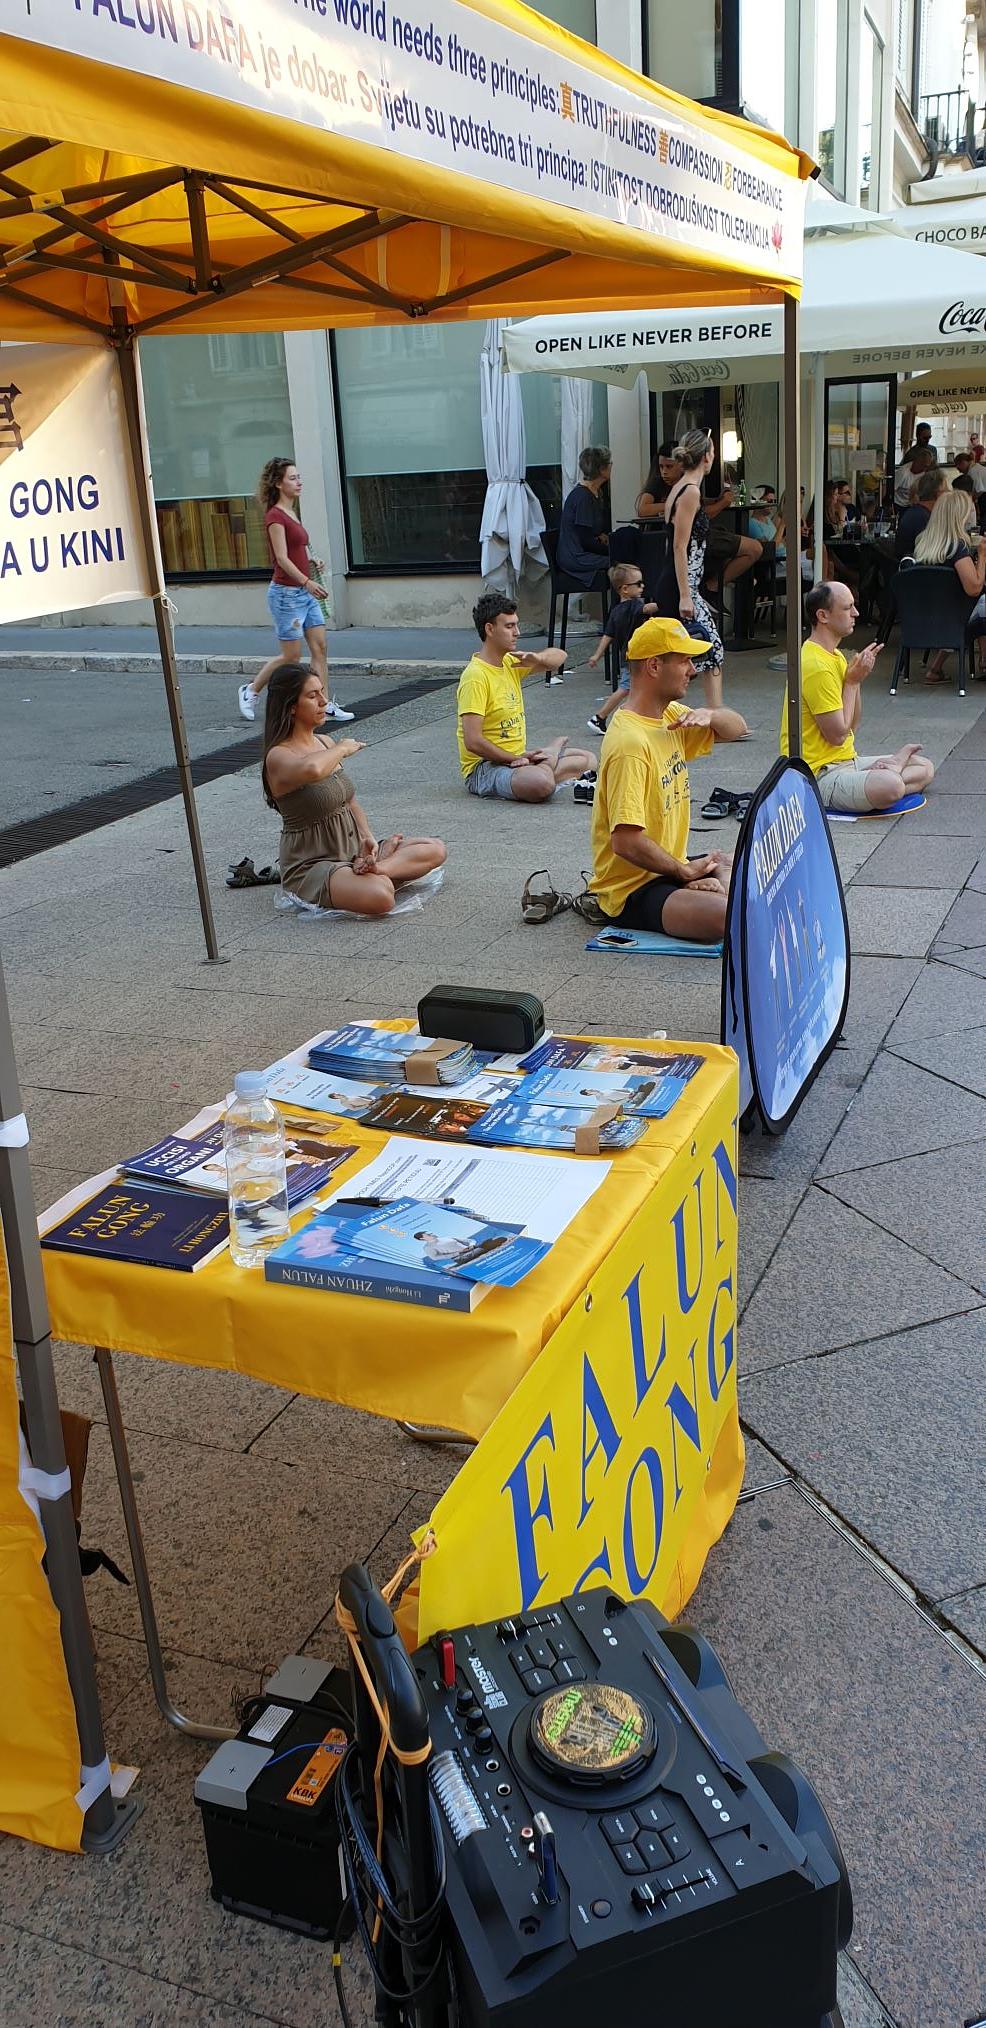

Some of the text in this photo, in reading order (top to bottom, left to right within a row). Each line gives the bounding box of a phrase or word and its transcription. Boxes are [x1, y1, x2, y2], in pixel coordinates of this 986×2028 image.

[332, 0, 387, 42] world
[392, 15, 443, 66] needs
[448, 33, 487, 85] three
[491, 58, 560, 115] principles:
[183, 1, 258, 73] DAFA
[258, 31, 282, 89] je
[287, 45, 355, 107] dobar.
[357, 70, 421, 131] Svijetu
[425, 105, 447, 140] su
[449, 114, 516, 163] potrebna
[518, 133, 534, 169] tri
[536, 142, 588, 192] principa:
[645, 183, 719, 234] DOBRODUŠNOST
[720, 211, 770, 250] TOLERANCIJA
[573, 90, 657, 157] TRUTHFULNESS
[668, 136, 724, 186] COMPASSION
[732, 167, 783, 212] FORBEARANCE
[915, 228, 967, 243] CHOCO
[535, 322, 773, 354] OPEN LIKE NEVER BEFORE
[910, 389, 935, 398] OPEN
[937, 388, 958, 397] LIKE
[10, 474, 100, 519] GONG
[1, 527, 126, 579] A U KINI
[753, 817, 784, 895] FALUN
[778, 791, 807, 855] DAFA
[144, 1145, 188, 1168] UCCISI
[165, 1147, 215, 1174] ORGANI
[67, 1194, 133, 1238] FALUN
[96, 1201, 150, 1240] GONG
[360, 1202, 411, 1227] Falun Dafa
[282, 1268, 325, 1285] FALUN
[327, 1275, 373, 1293] ZHUAN
[501, 1116, 739, 1612] FALUN
[735, 1858, 745, 1867] A
